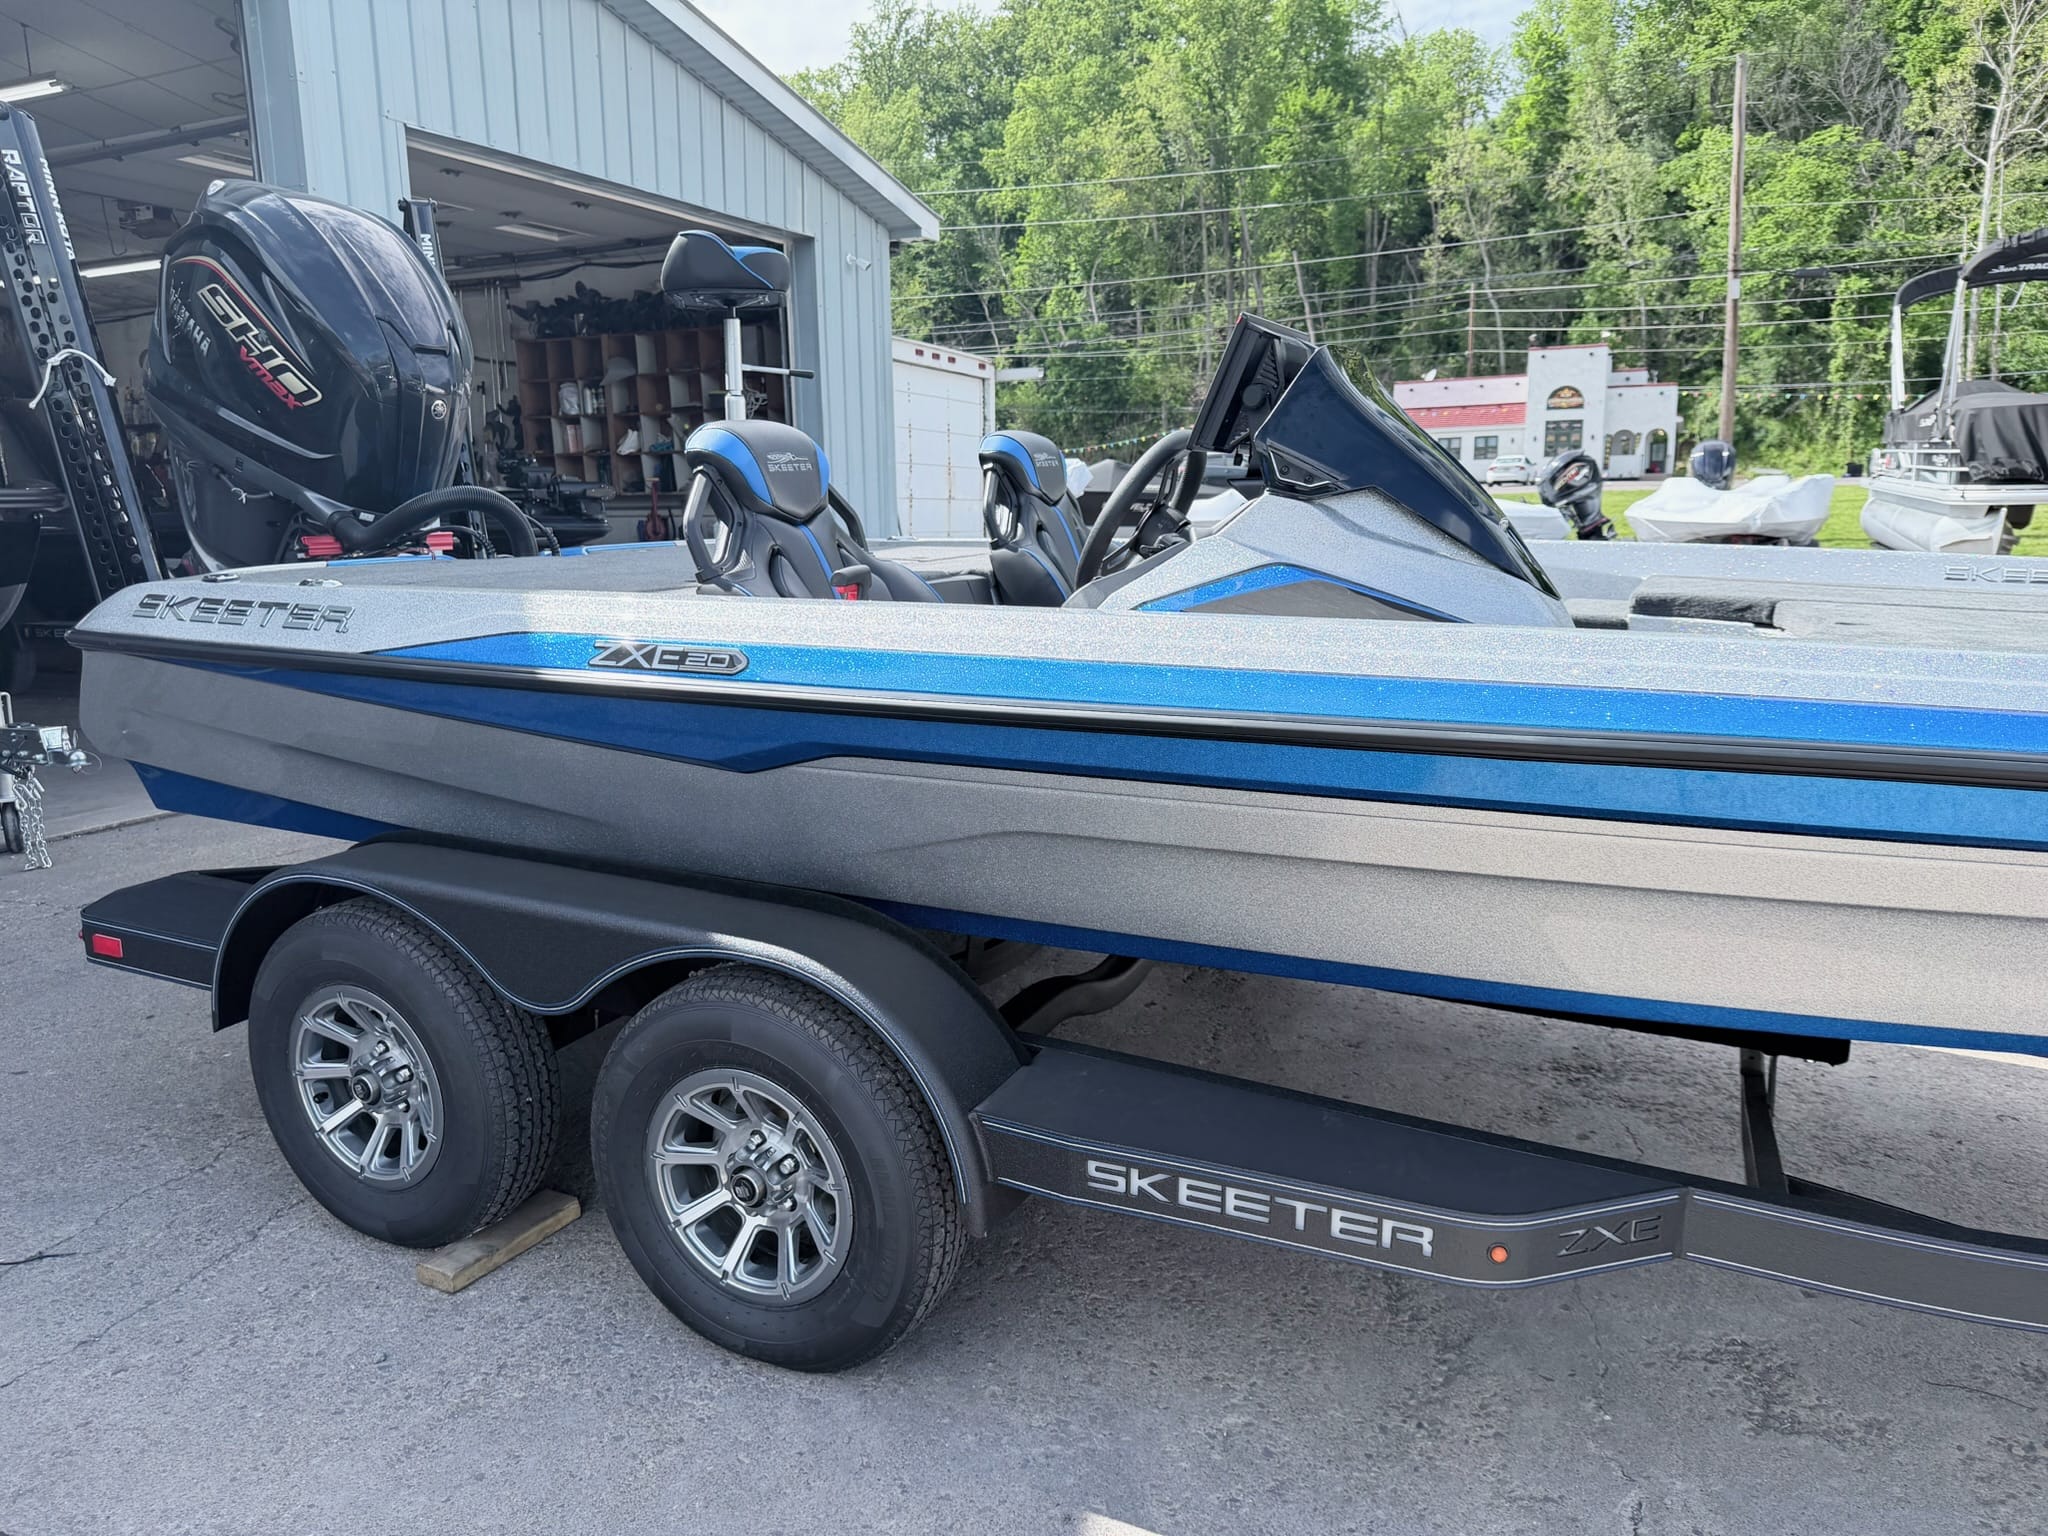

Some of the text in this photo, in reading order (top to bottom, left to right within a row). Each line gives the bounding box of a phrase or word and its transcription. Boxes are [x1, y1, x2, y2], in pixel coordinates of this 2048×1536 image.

[1, 149, 46, 245] RAPTOR
[40, 157, 76, 260] MINN KOTA
[197, 284, 323, 407] SHO
[767, 463, 813, 472] SKEETER
[132, 593, 355, 634] SKEETER
[1087, 1160, 1434, 1258] SKEETER
[1556, 1215, 1662, 1257] ZXE
